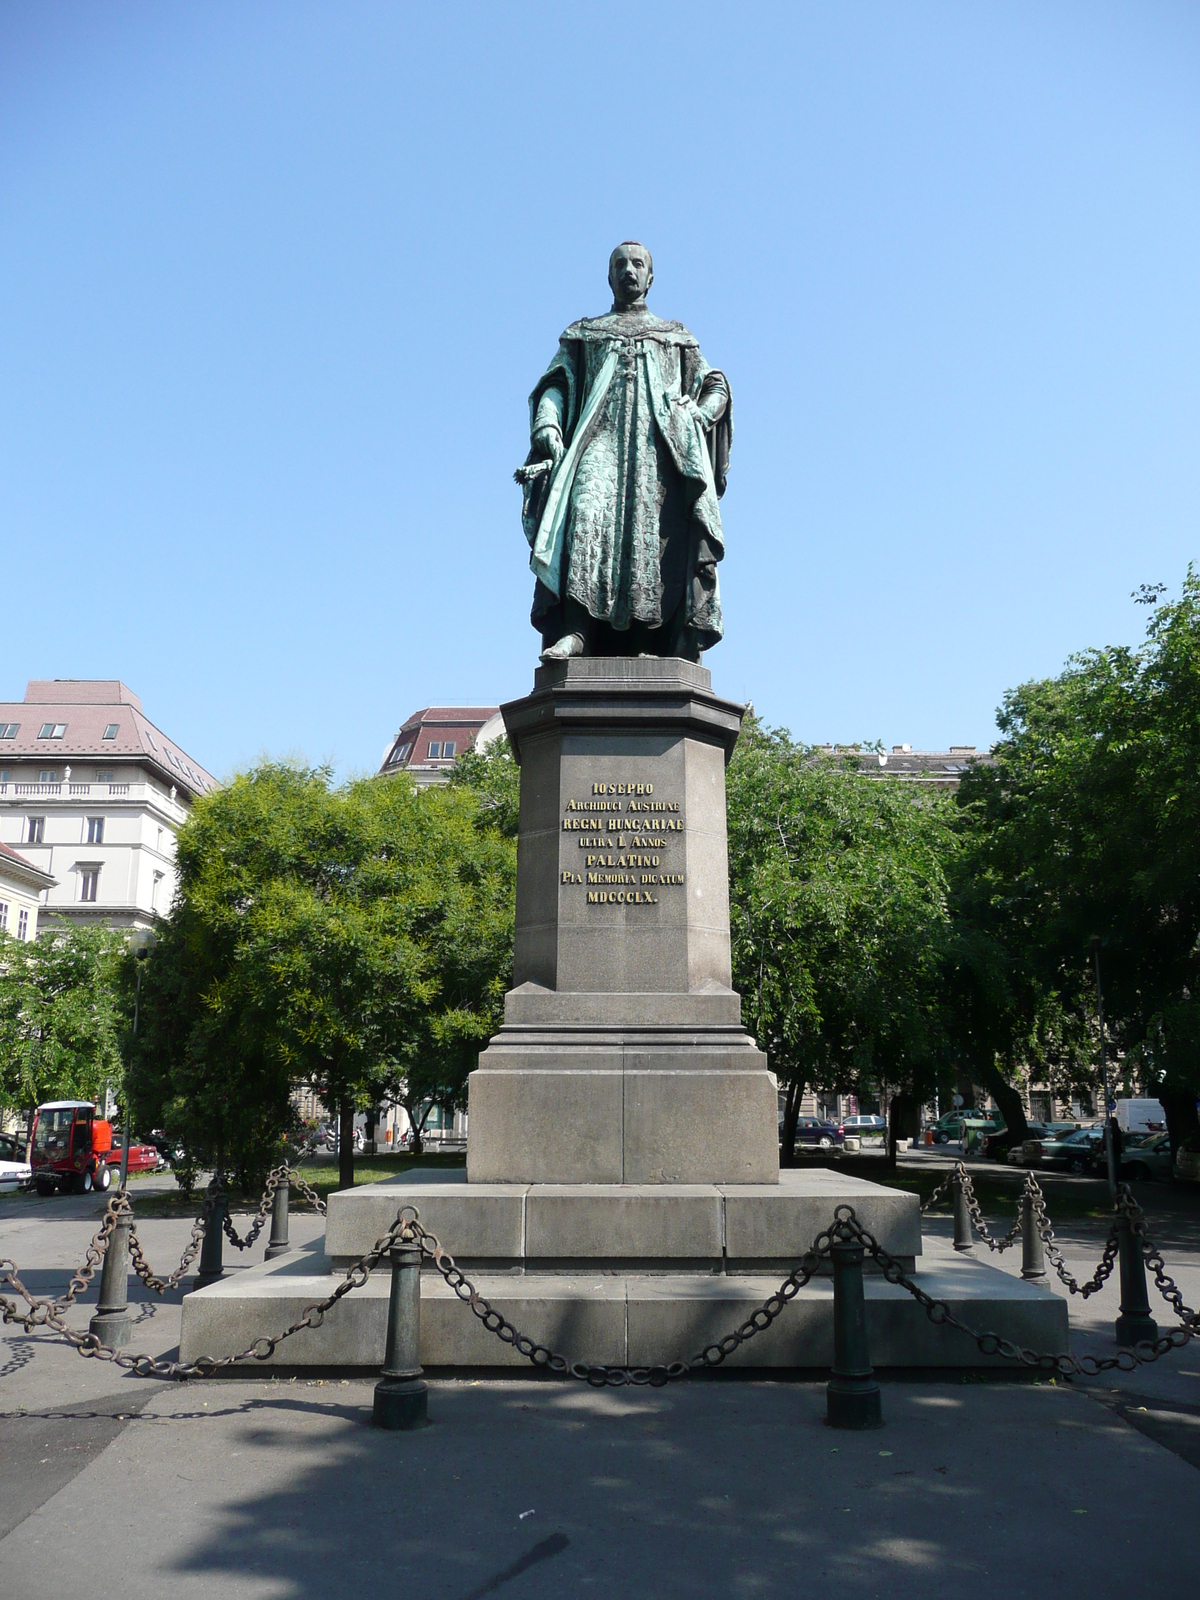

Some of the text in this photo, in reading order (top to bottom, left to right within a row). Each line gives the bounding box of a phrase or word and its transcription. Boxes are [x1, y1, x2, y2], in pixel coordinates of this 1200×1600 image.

[593, 783, 654, 794] IOSEPHO
[567, 799, 679, 810] ARCHIDUCI AUSTRIAE
[563, 819, 684, 830] REGNI HUNGARIAE
[580, 836, 667, 847] ULTRA L ANNOS
[587, 855, 660, 866] PALATINO
[562, 872, 684, 884] PIA MEMORIA DICATUM
[588, 892, 658, 903] MDCCCLX.
